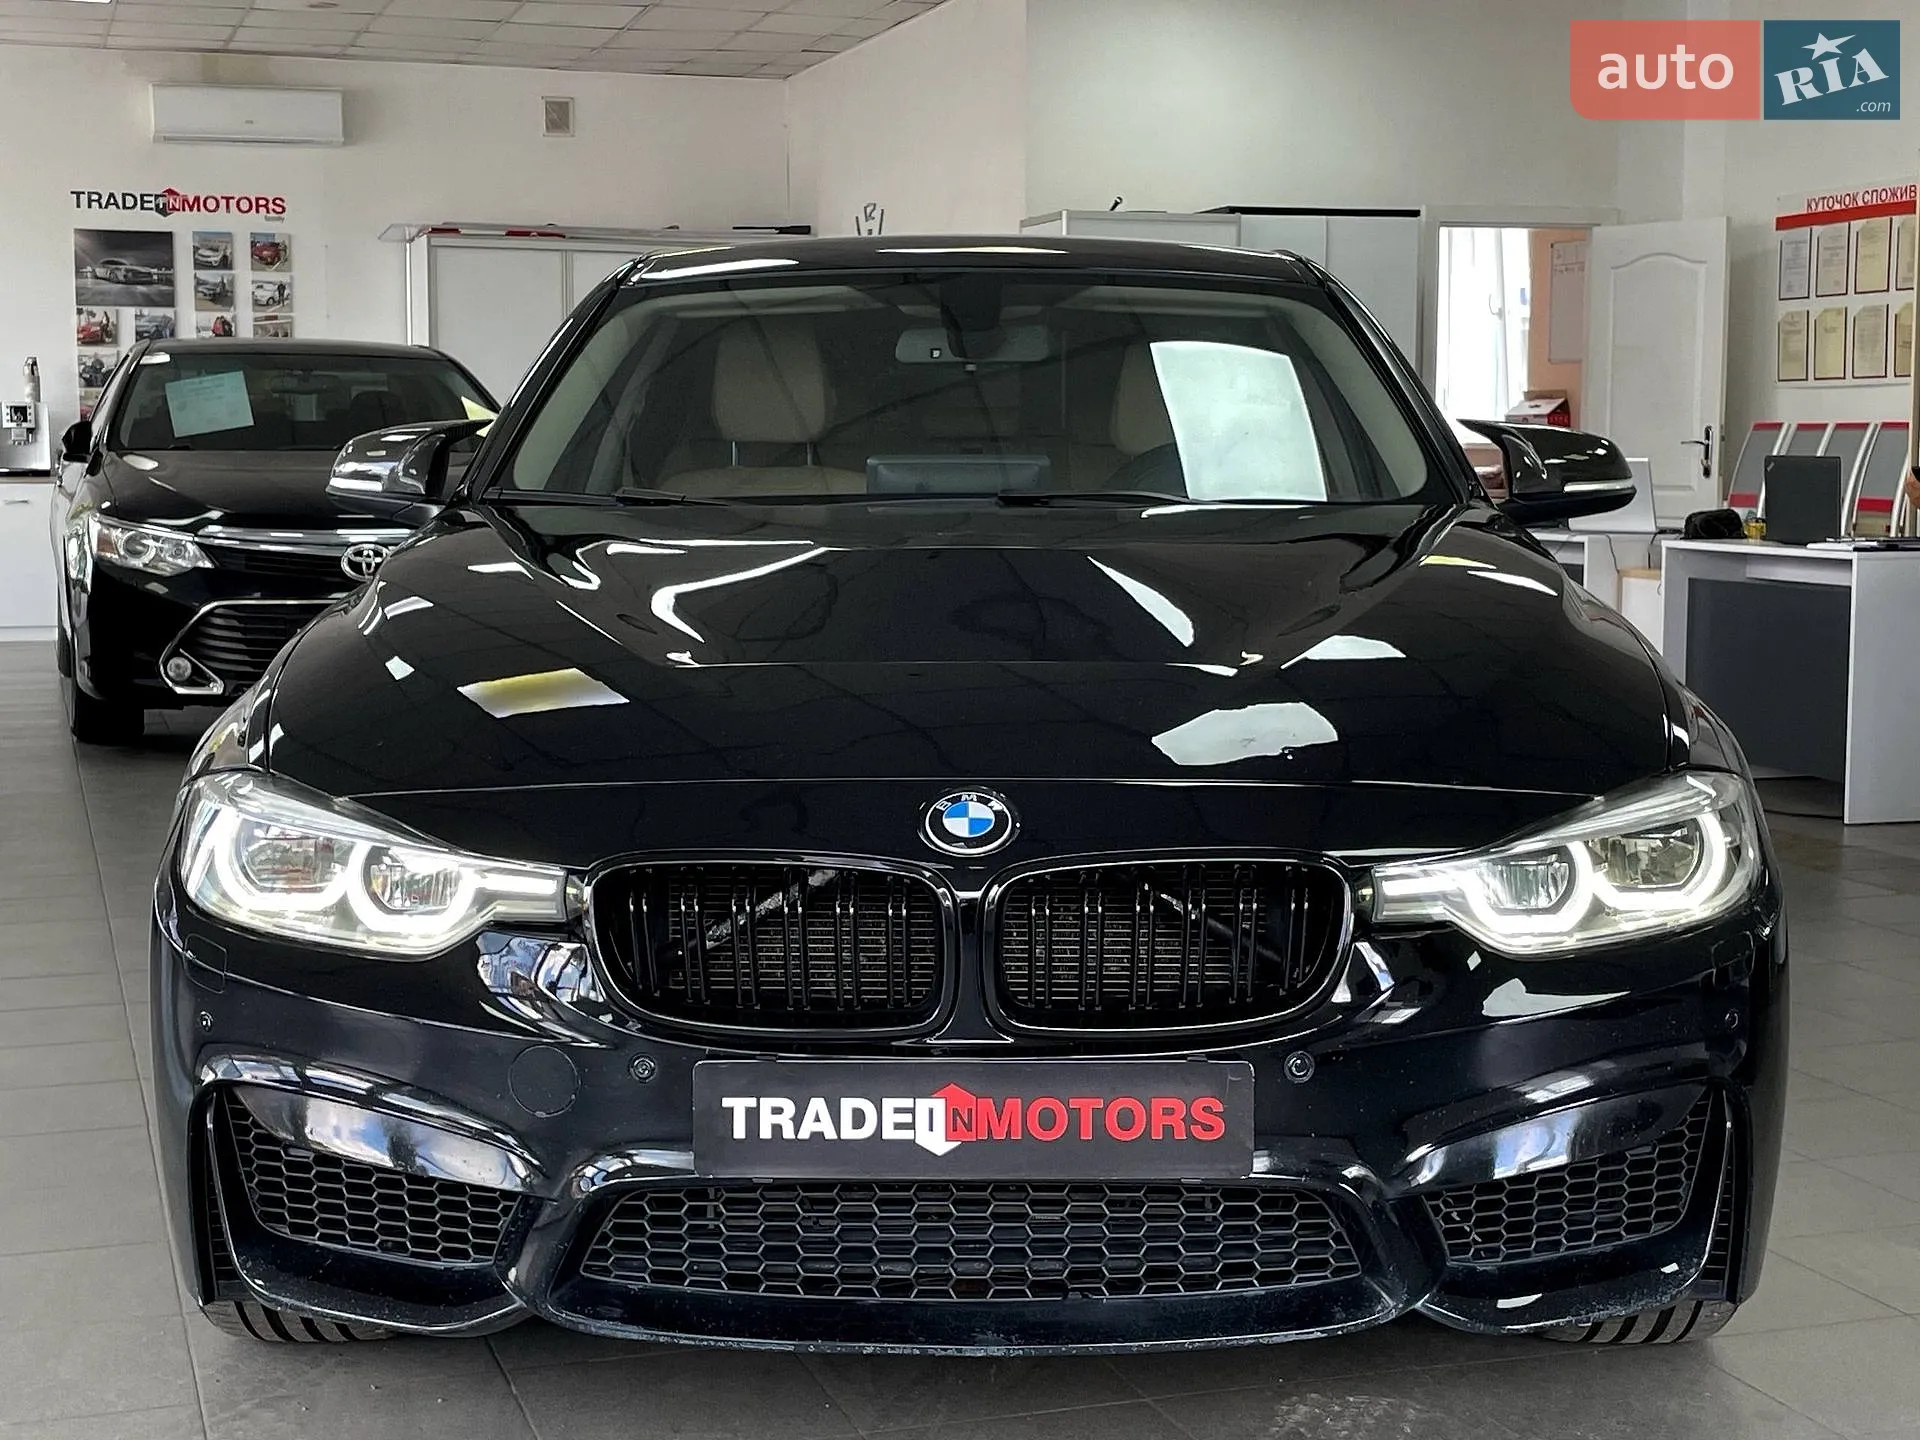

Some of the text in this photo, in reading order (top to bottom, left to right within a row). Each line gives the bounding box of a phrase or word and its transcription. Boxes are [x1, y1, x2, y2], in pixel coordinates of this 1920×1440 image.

[1806, 184, 1917, 212] КУТОЧОК СПОЖИВ
[935, 793, 1004, 812] BMW
